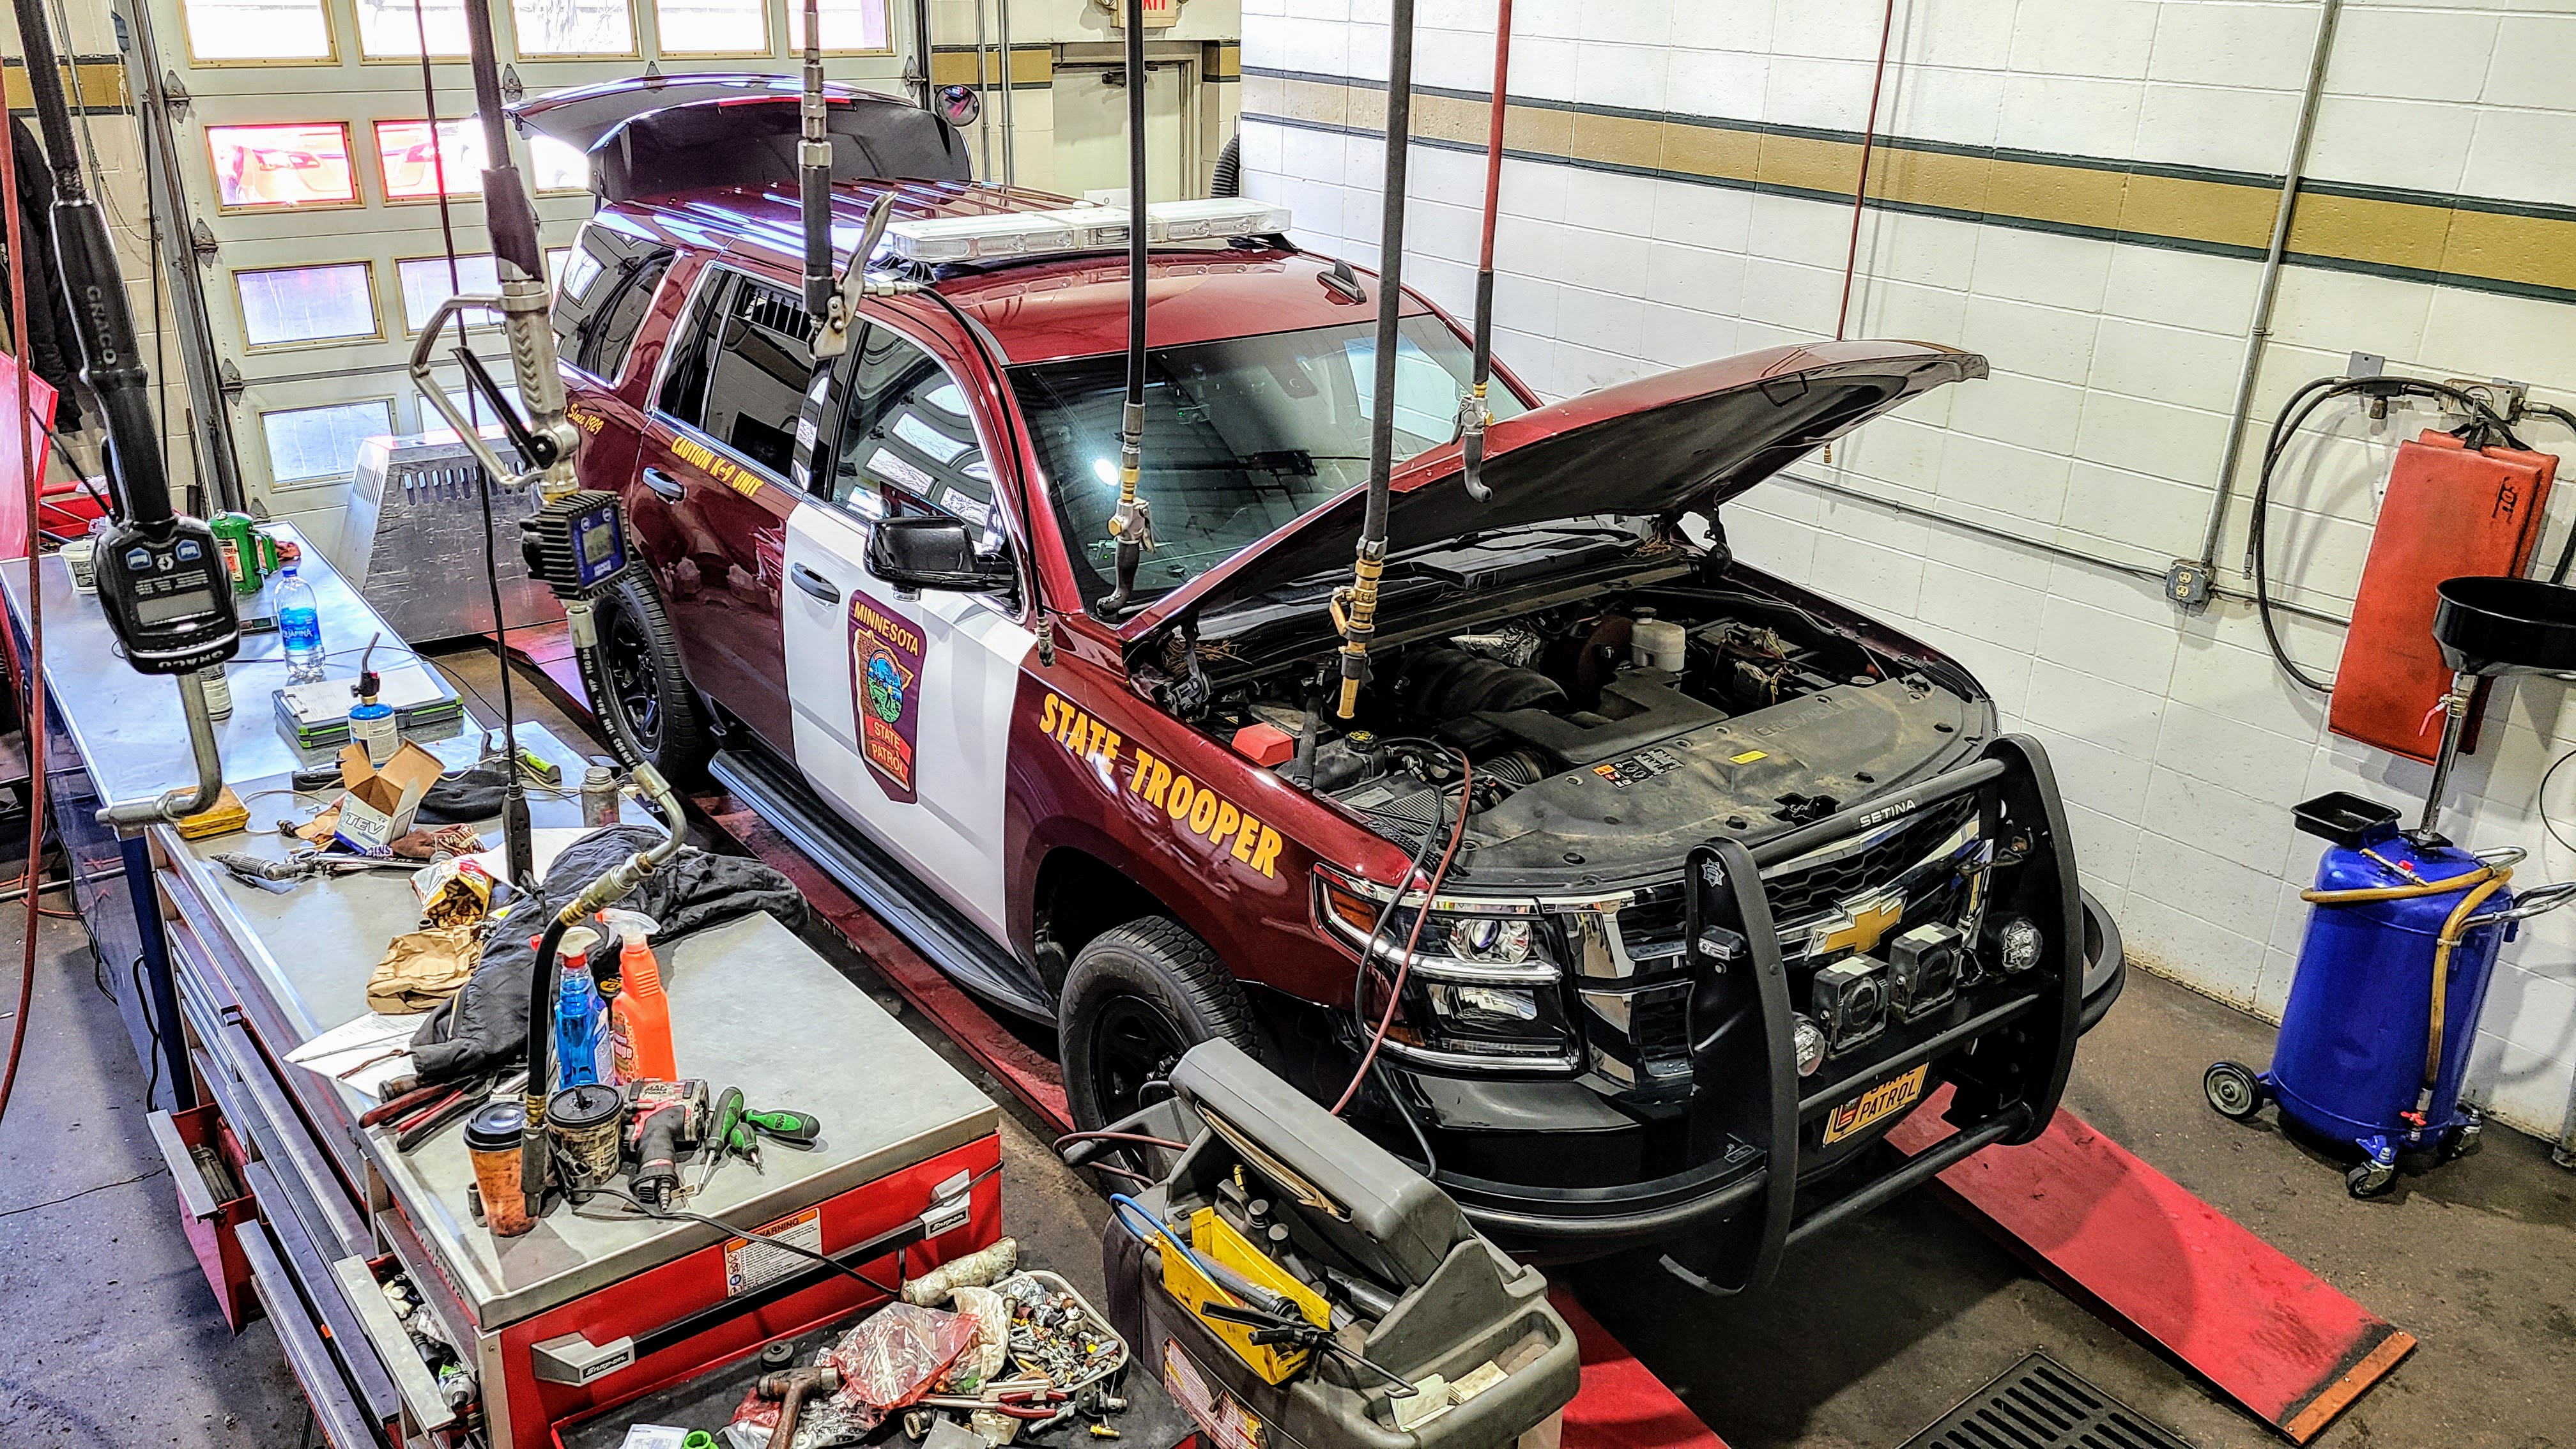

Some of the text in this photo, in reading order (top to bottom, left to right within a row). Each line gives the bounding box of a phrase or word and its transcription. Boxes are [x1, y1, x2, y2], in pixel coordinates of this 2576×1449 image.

[567, 403, 586, 425] Since
[584, 415, 604, 435] 1929
[671, 436, 764, 497] CAUTION K-9 UNIT
[282, 628, 313, 639] QUAFINA
[854, 601, 919, 656] MINNESOTA
[873, 721, 901, 751] STATE
[871, 743, 906, 779] PATROL
[1039, 693, 1282, 879] STATE TROOPER
[346, 811, 385, 835] TEV
[1859, 799, 1915, 827] SETINA
[1859, 1078, 1915, 1123] PATROL
[585, 1355, 626, 1376] Snap-on
